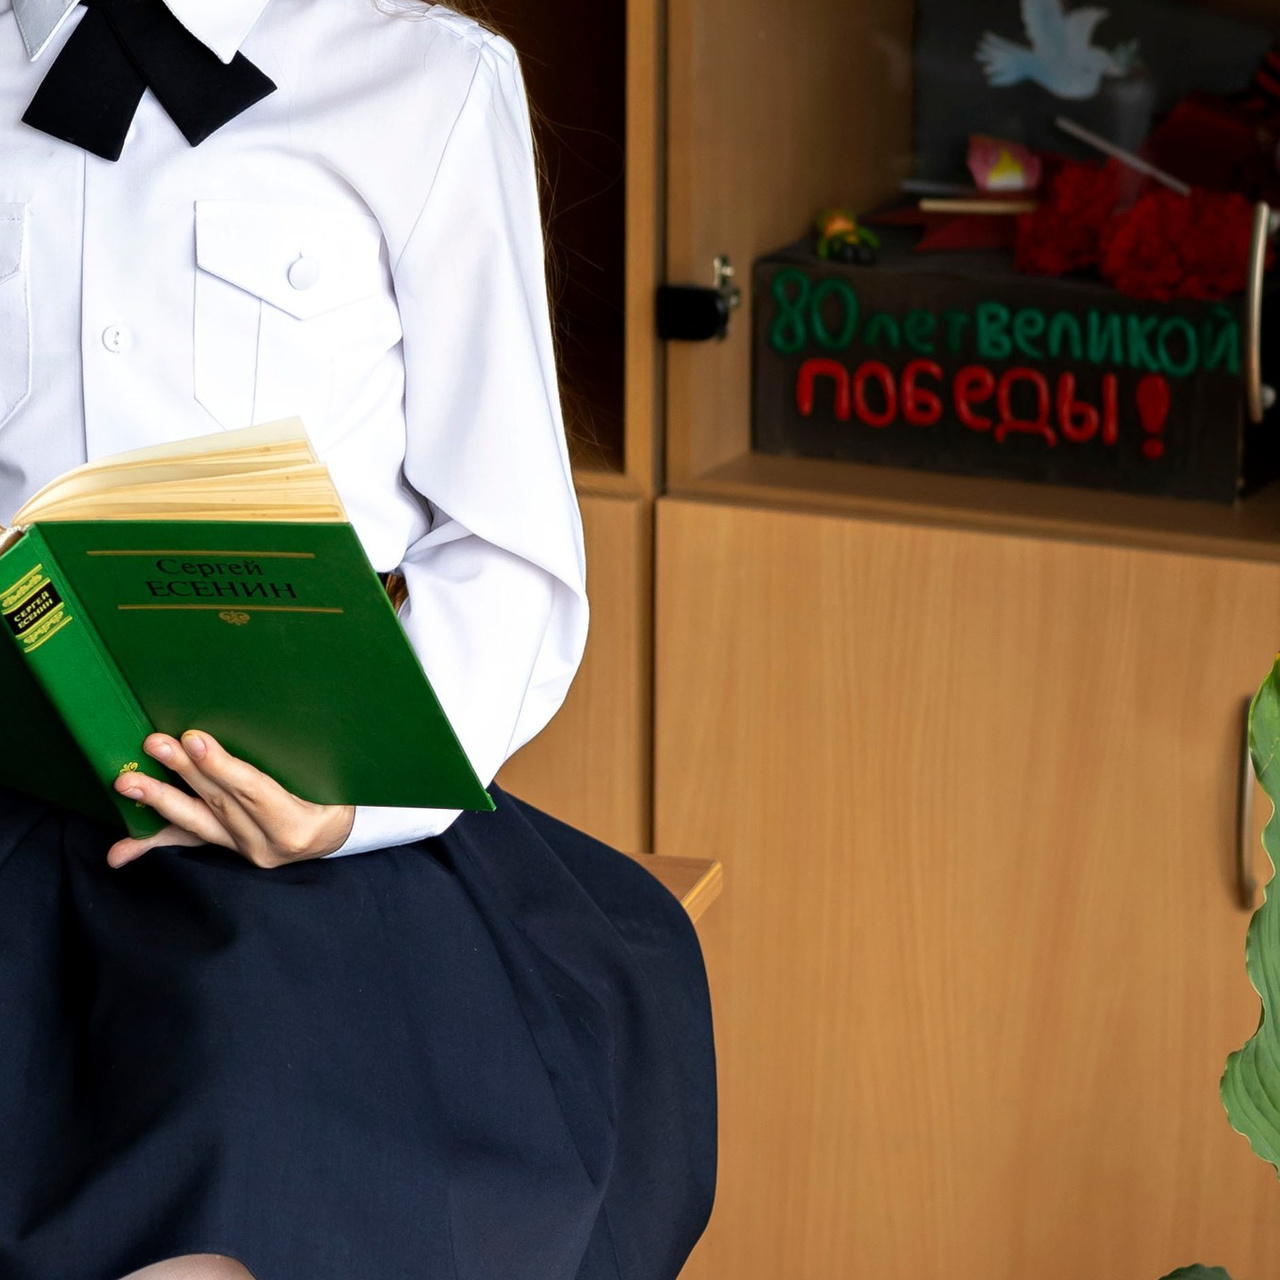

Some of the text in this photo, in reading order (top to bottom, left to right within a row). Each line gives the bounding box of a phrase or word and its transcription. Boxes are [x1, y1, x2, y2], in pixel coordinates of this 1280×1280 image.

[768, 268, 859, 355] 80
[862, 312, 965, 355] лет
[156, 557, 264, 578] Сергей
[145, 580, 298, 600] ЕСЕНИН
[14, 591, 50, 622] СЕРГЕЙ
[18, 598, 54, 629] ЕСЕНИН
